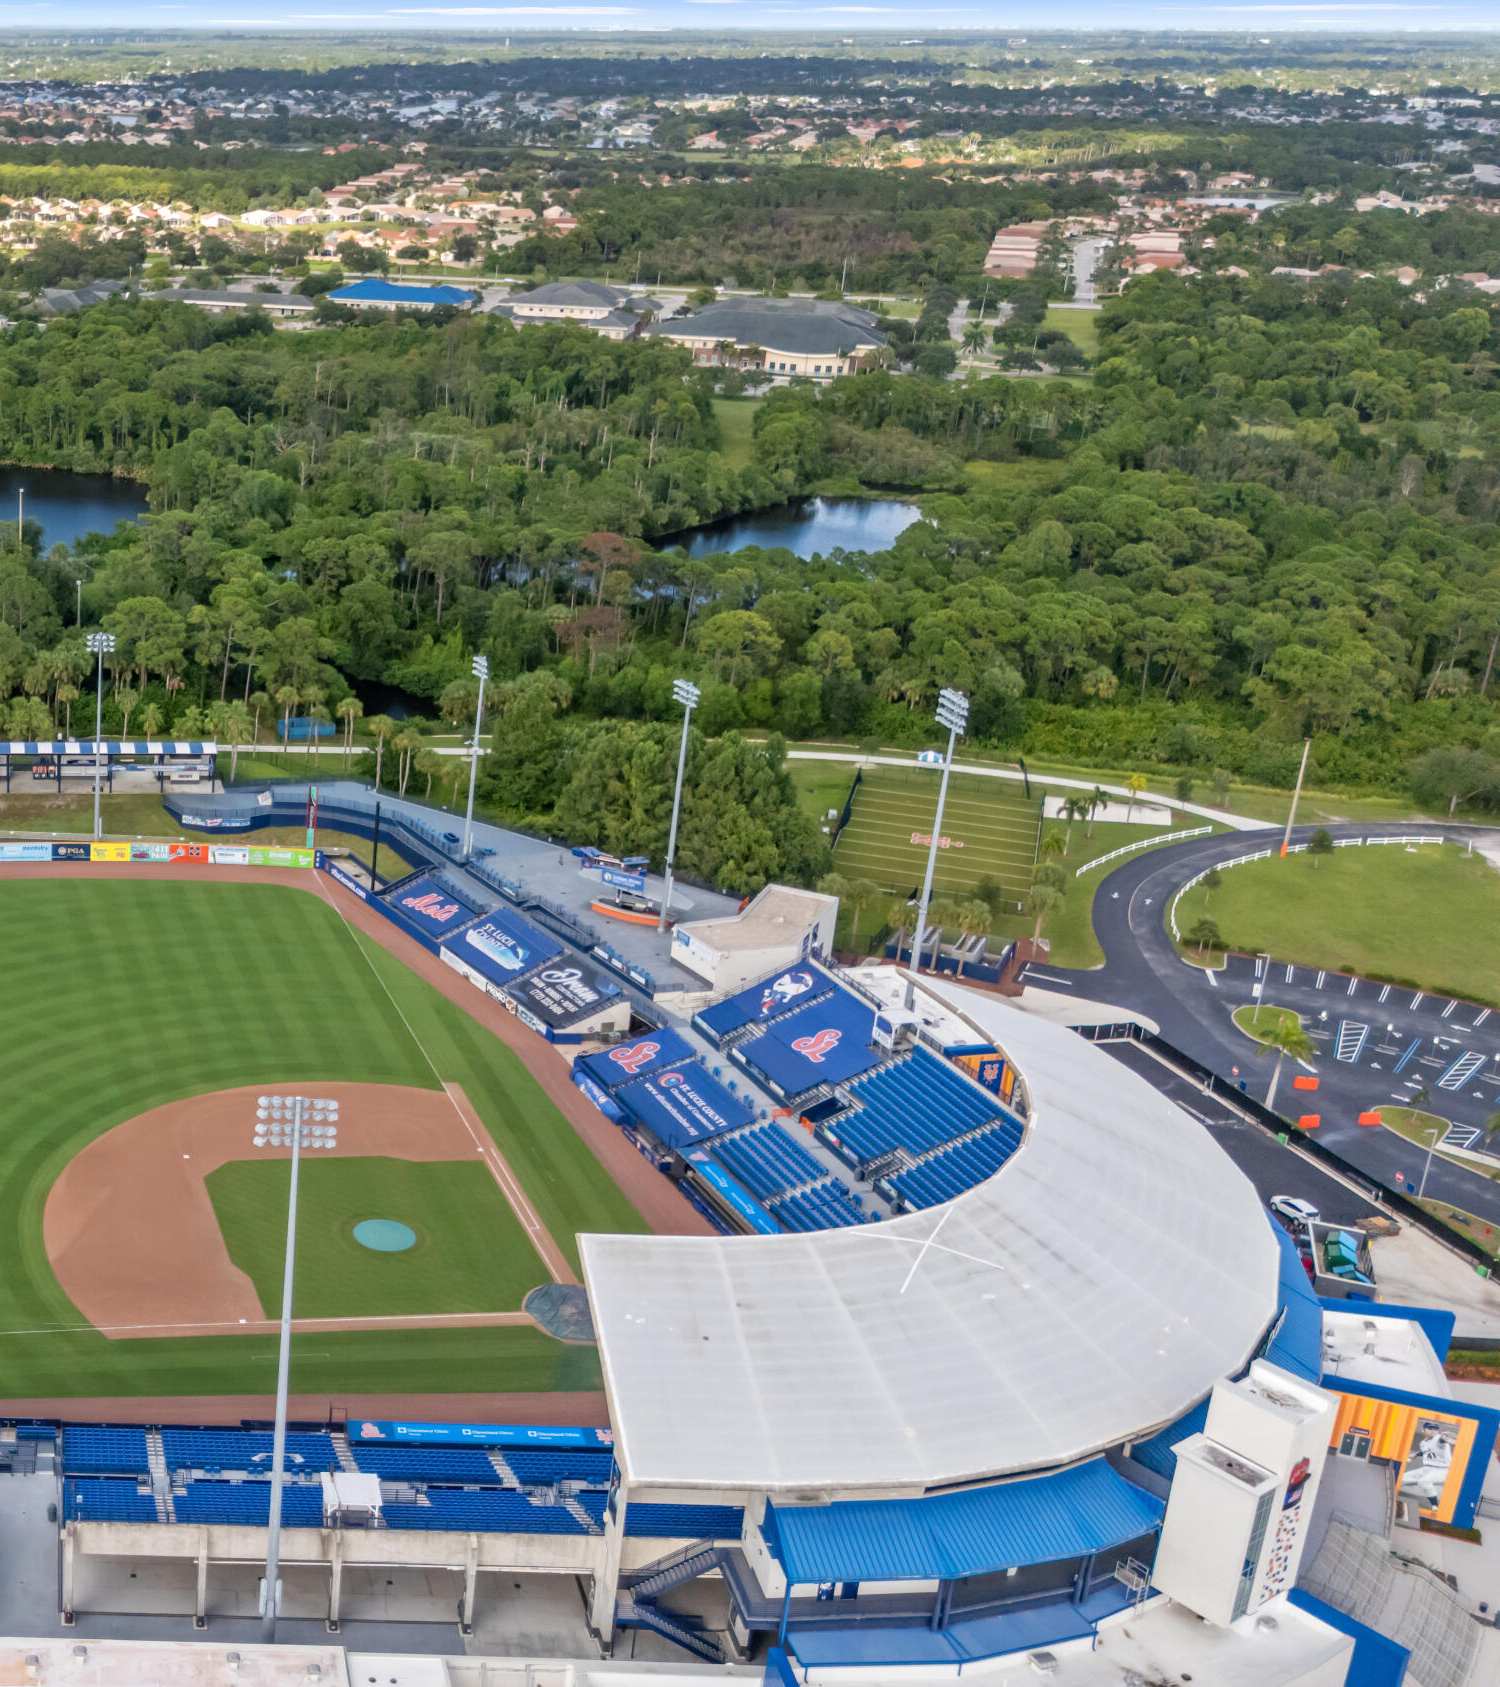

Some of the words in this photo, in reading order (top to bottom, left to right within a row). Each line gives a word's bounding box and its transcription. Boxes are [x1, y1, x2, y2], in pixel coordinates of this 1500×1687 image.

[402, 893, 460, 922] Mets
[475, 928, 507, 950] COUNTY
[494, 929, 517, 947] LUCIE
[540, 968, 599, 1003] Dream
[670, 1088, 690, 1106] Chamber
[692, 1110, 716, 1131] Commerce
[687, 1092, 706, 1107] LUCIE
[702, 1106, 729, 1127] COUNTY
